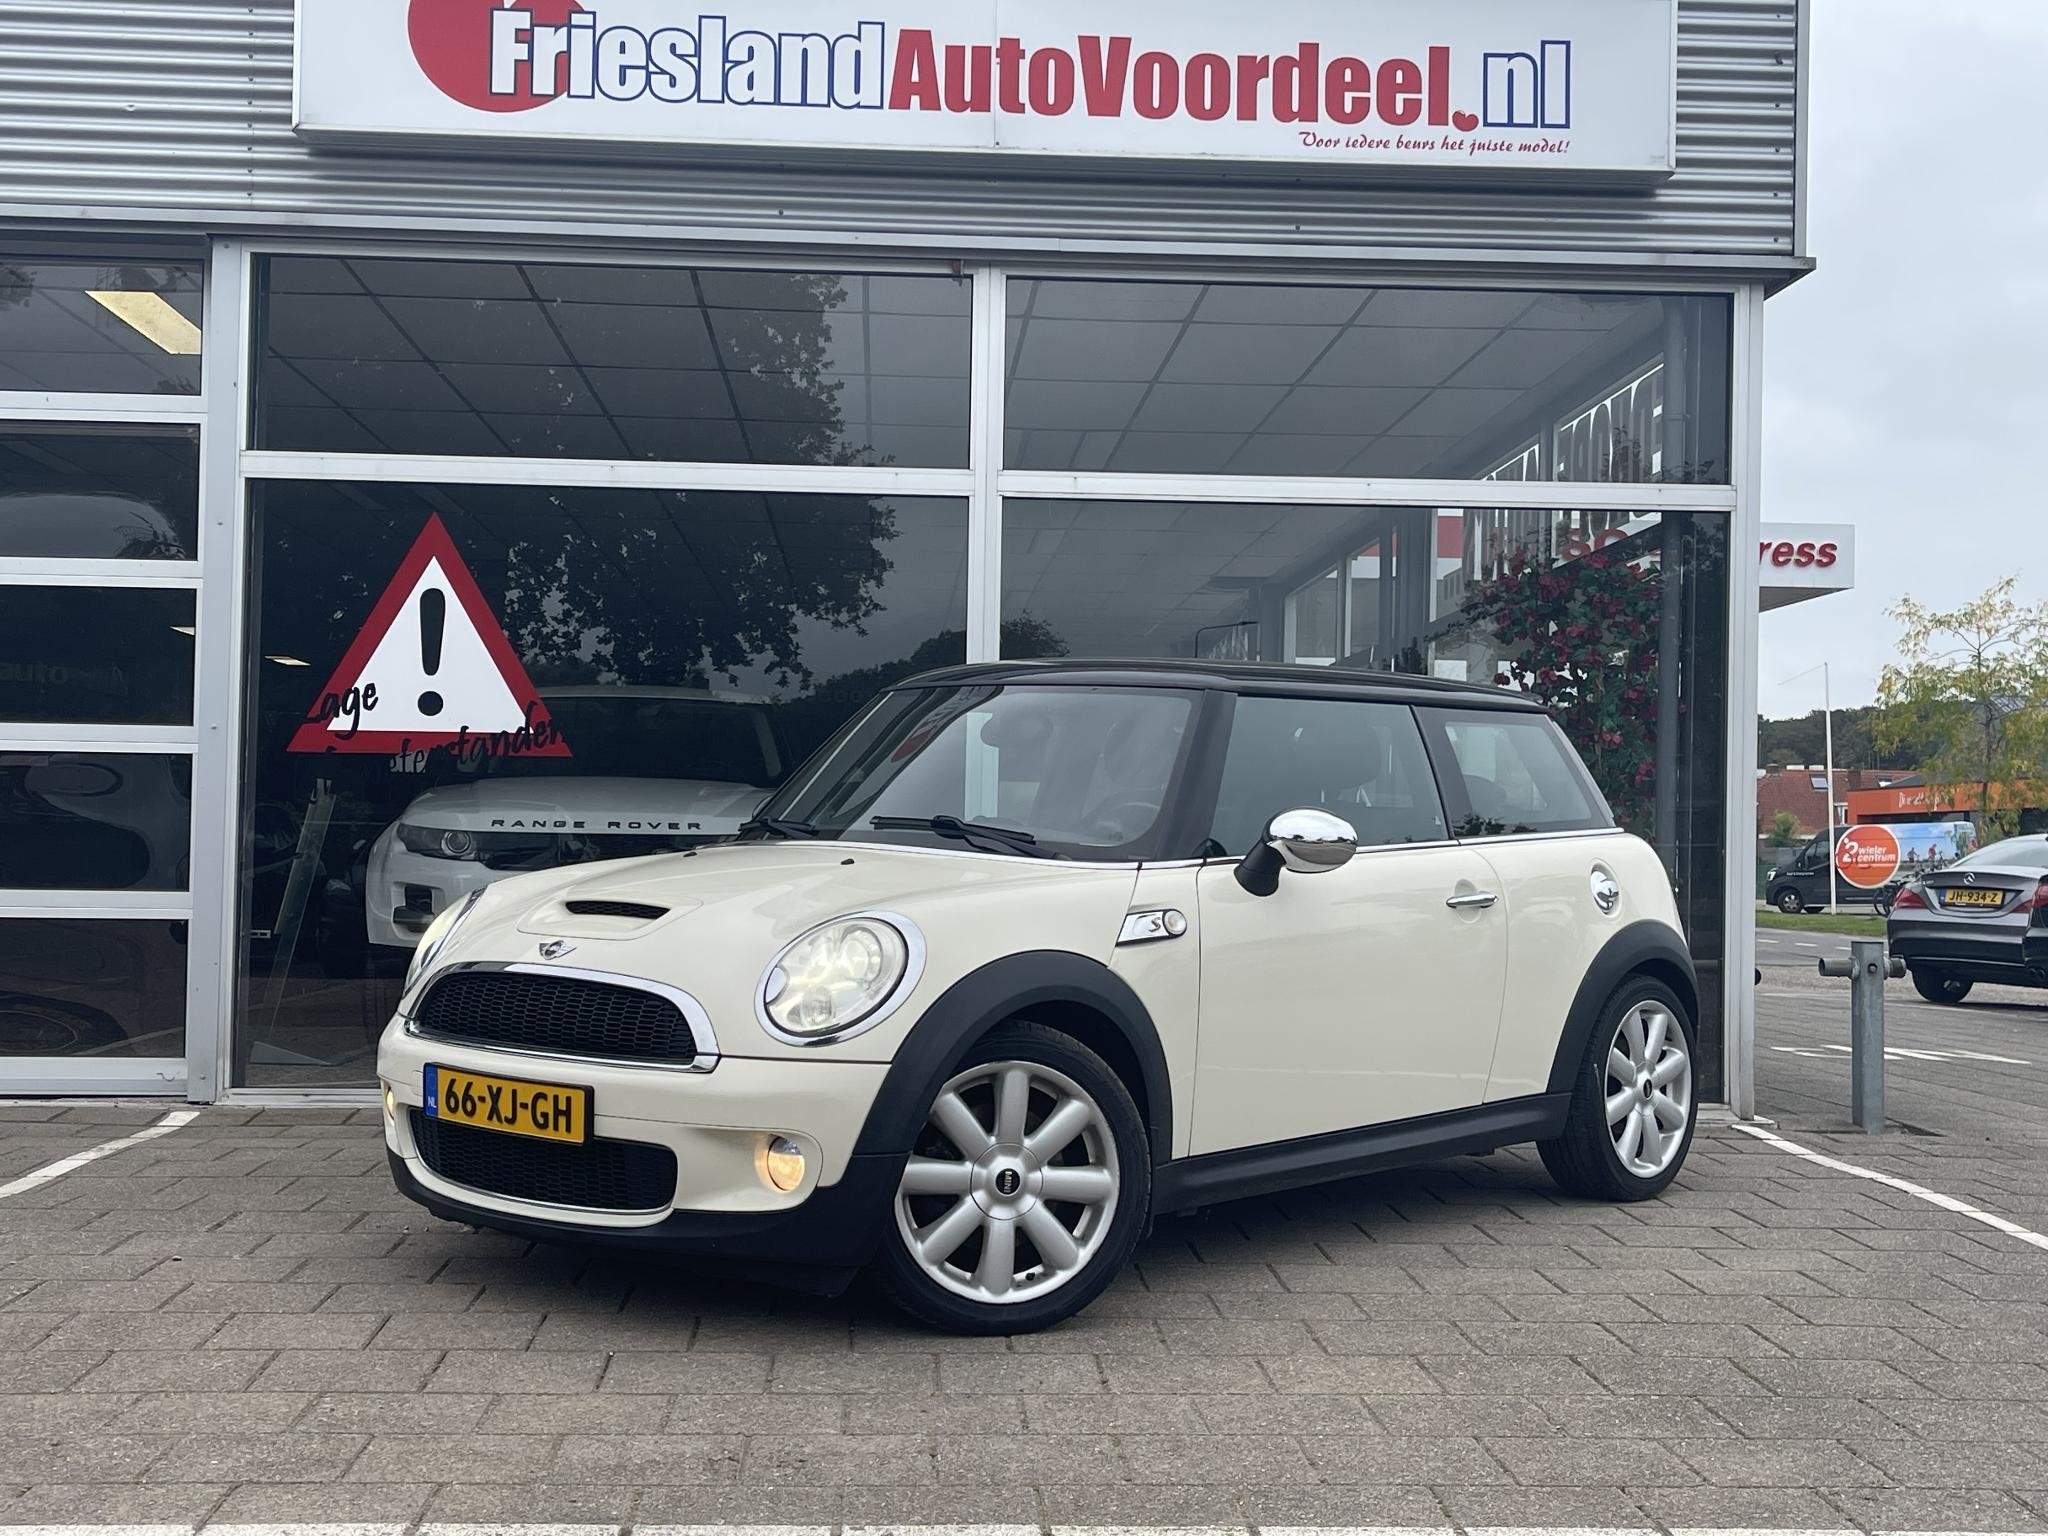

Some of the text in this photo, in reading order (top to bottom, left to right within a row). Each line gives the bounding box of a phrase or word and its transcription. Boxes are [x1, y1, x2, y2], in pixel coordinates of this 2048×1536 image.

[1299, 131, 1570, 156] Voor iedere beurs het juiste model!
[490, 819, 702, 831] RANGE ROVER
[1857, 853, 1896, 863] centrum
[1949, 889, 1998, 903] JH-934-Z
[444, 1078, 573, 1134] 66-XJ-GH
